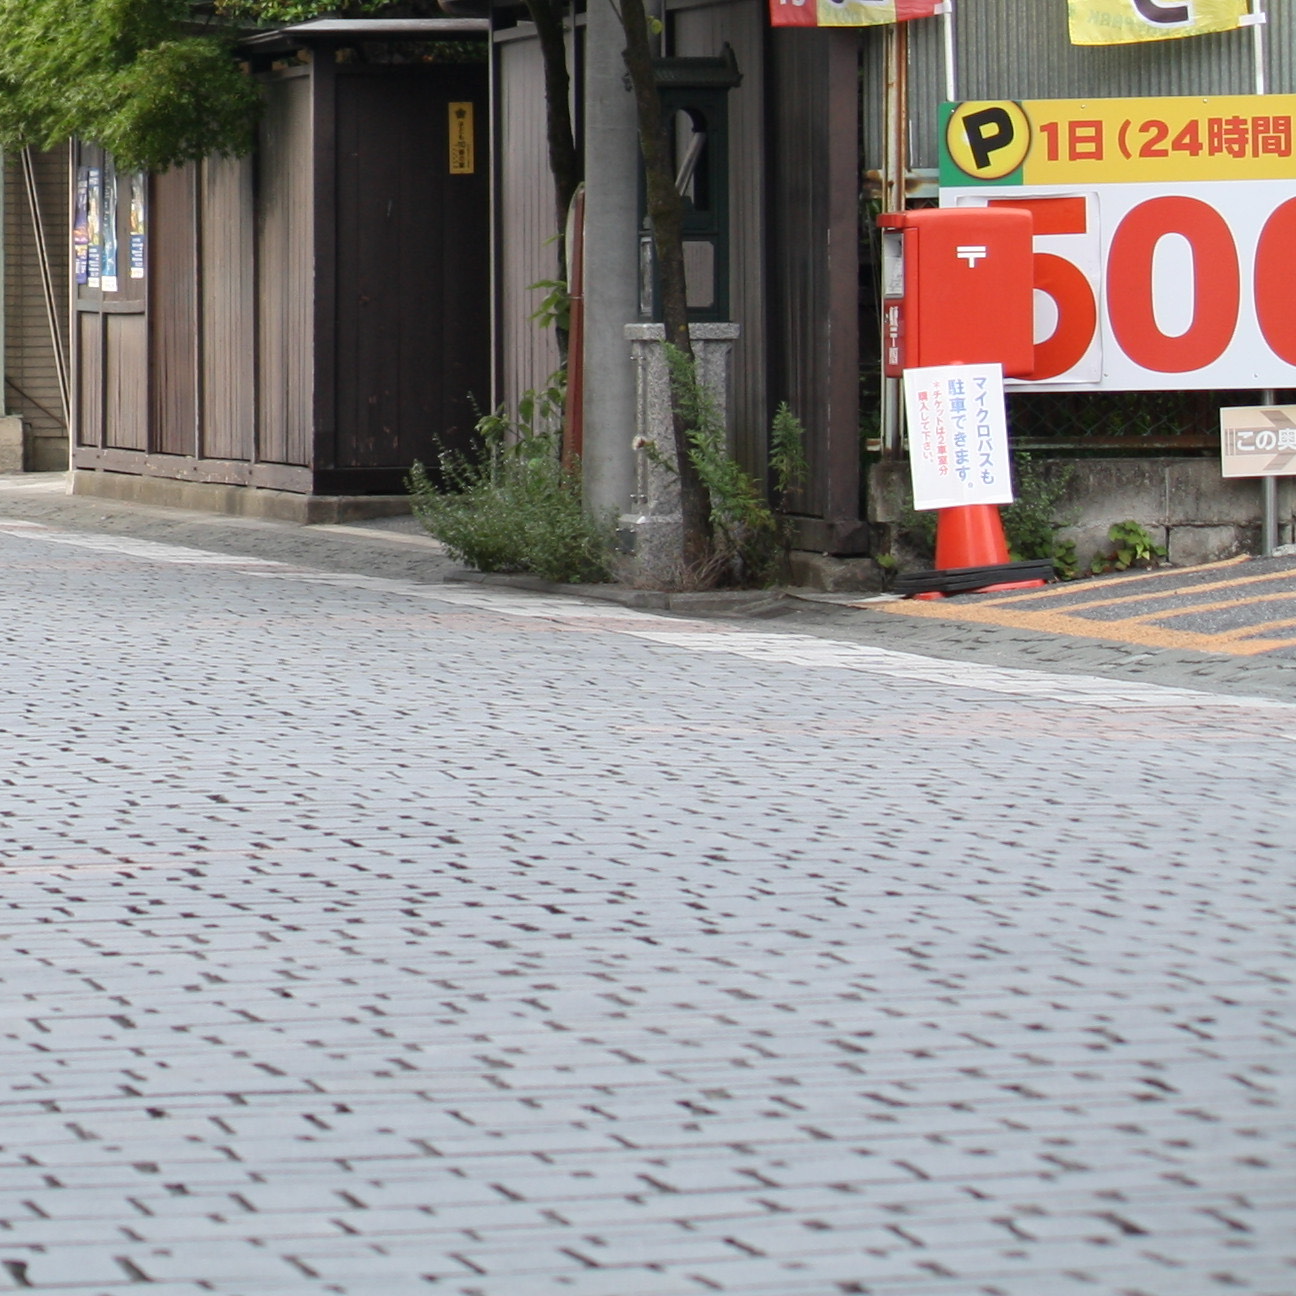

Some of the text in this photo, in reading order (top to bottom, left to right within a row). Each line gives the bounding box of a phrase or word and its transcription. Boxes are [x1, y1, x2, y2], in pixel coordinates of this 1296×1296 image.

[962, 106, 1015, 170] P
[973, 377, 995, 485] マイクロバスも
